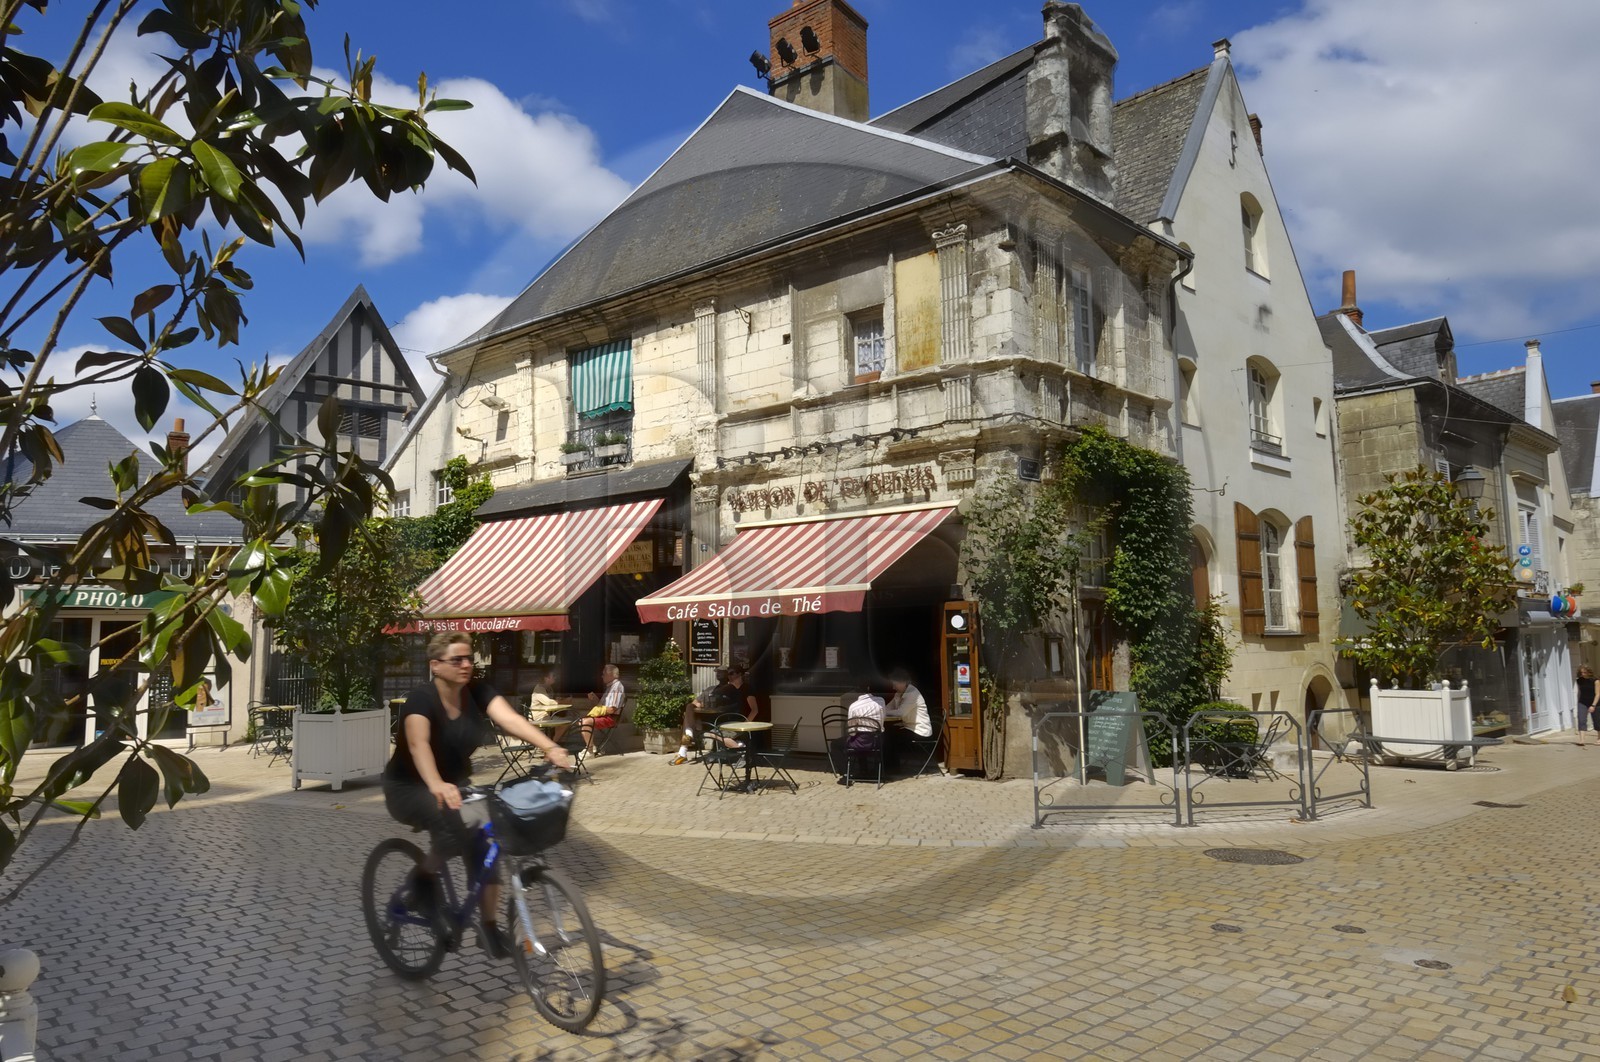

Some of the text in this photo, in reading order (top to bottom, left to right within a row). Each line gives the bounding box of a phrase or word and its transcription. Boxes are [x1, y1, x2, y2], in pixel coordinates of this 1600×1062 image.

[74, 591, 144, 608] PHOTO
[667, 595, 822, 619] Café Salon de Thé
[463, 617, 522, 630] Chocolatier
